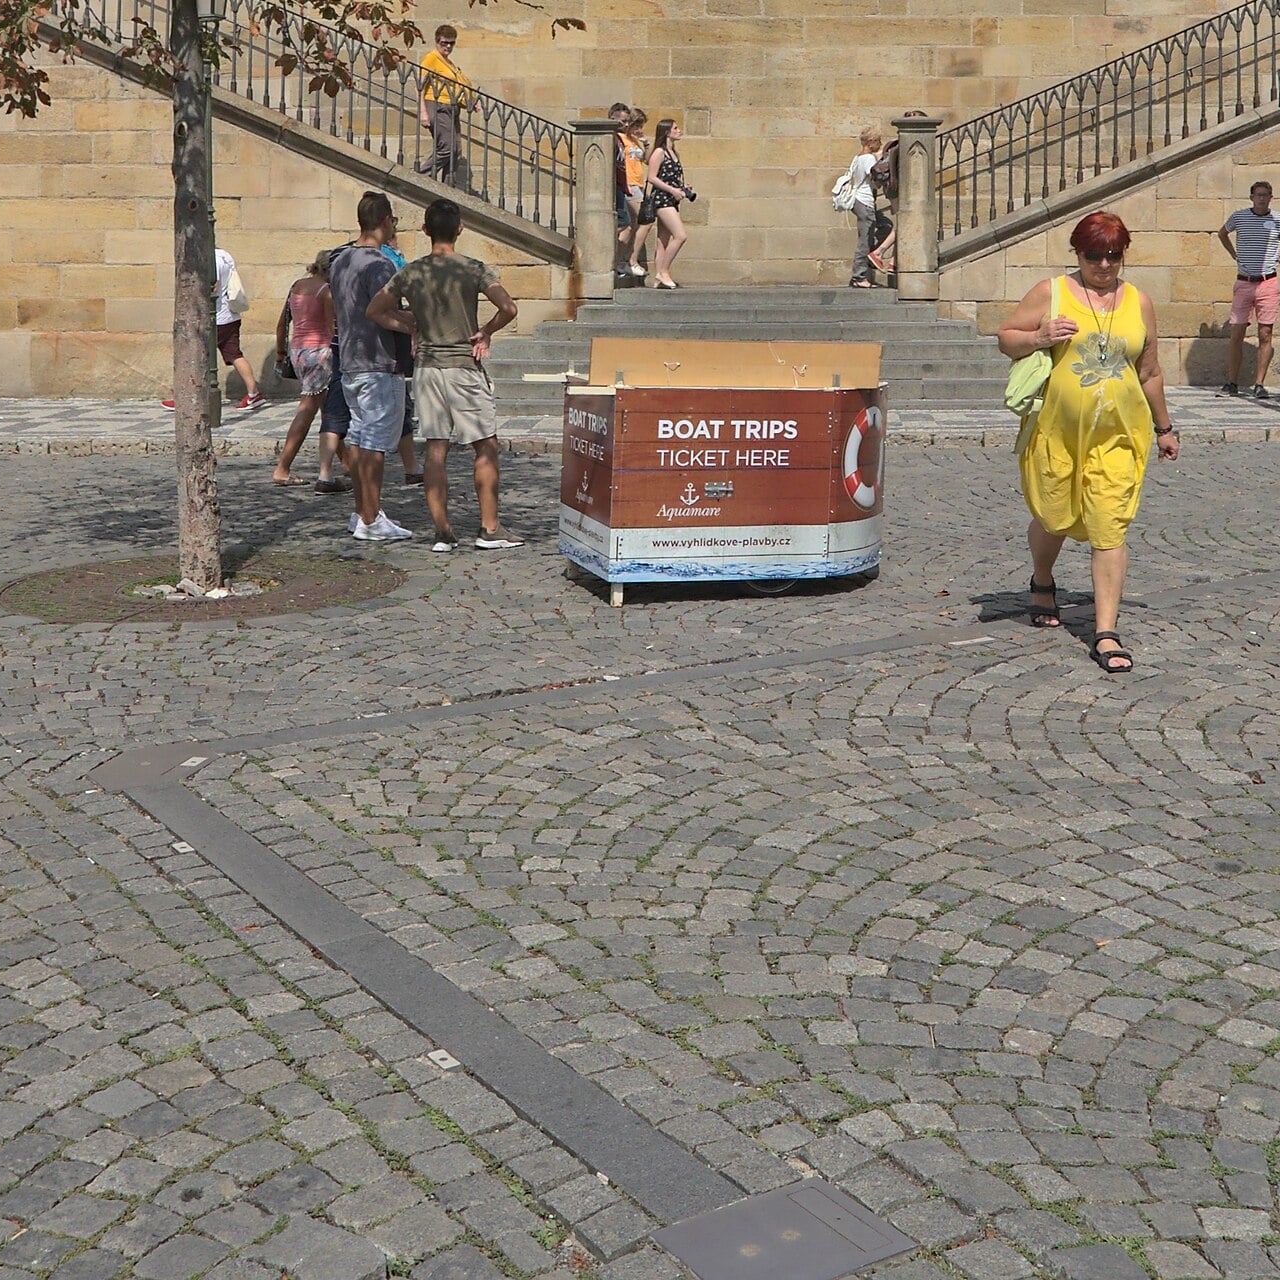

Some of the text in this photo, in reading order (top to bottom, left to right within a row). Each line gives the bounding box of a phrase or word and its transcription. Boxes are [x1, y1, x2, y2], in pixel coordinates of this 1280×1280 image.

[568, 407, 608, 436] BOAT TRIPS
[657, 419, 798, 439] BOAT TRIPS
[570, 435, 604, 461] TICKET HERE
[656, 449, 790, 466] TICKET HERE
[656, 503, 721, 521] Aquamare
[652, 537, 792, 549] www.vyhlidkove-plavby.cz
